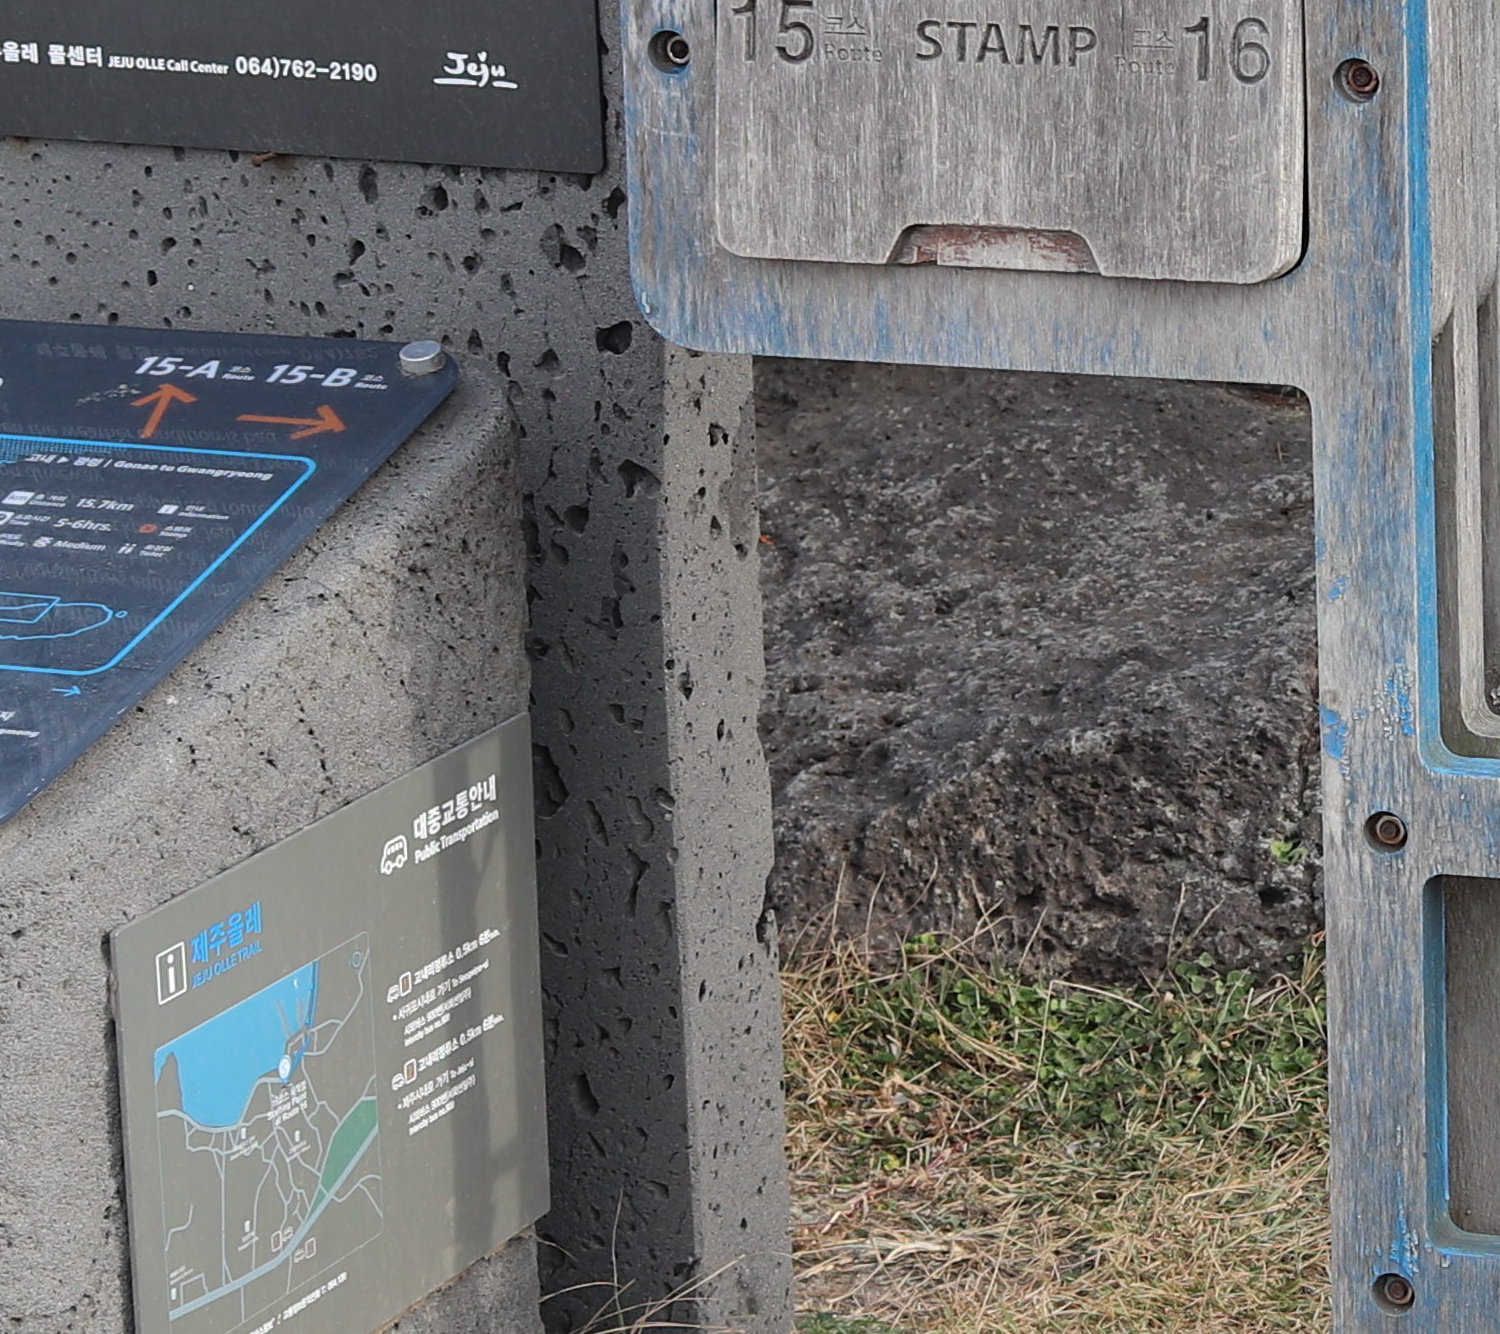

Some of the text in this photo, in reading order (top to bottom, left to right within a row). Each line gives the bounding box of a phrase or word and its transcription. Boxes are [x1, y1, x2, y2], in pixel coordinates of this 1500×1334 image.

[48, 43, 102, 67] 콜센터
[825, 41, 883, 63] Route
[915, 19, 1099, 69] STAMP
[1182, 15, 1271, 85] 16
[1115, 53, 1176, 76] Route
[134, 357, 221, 379] 15-A
[266, 364, 358, 387] 15-B
[113, 460, 159, 471] Gonae
[76, 498, 135, 511] 15.7km
[413, 774, 496, 840] 대중교통안내
[414, 810, 499, 864] Public Transportation
[190, 902, 262, 964] 제주올레
